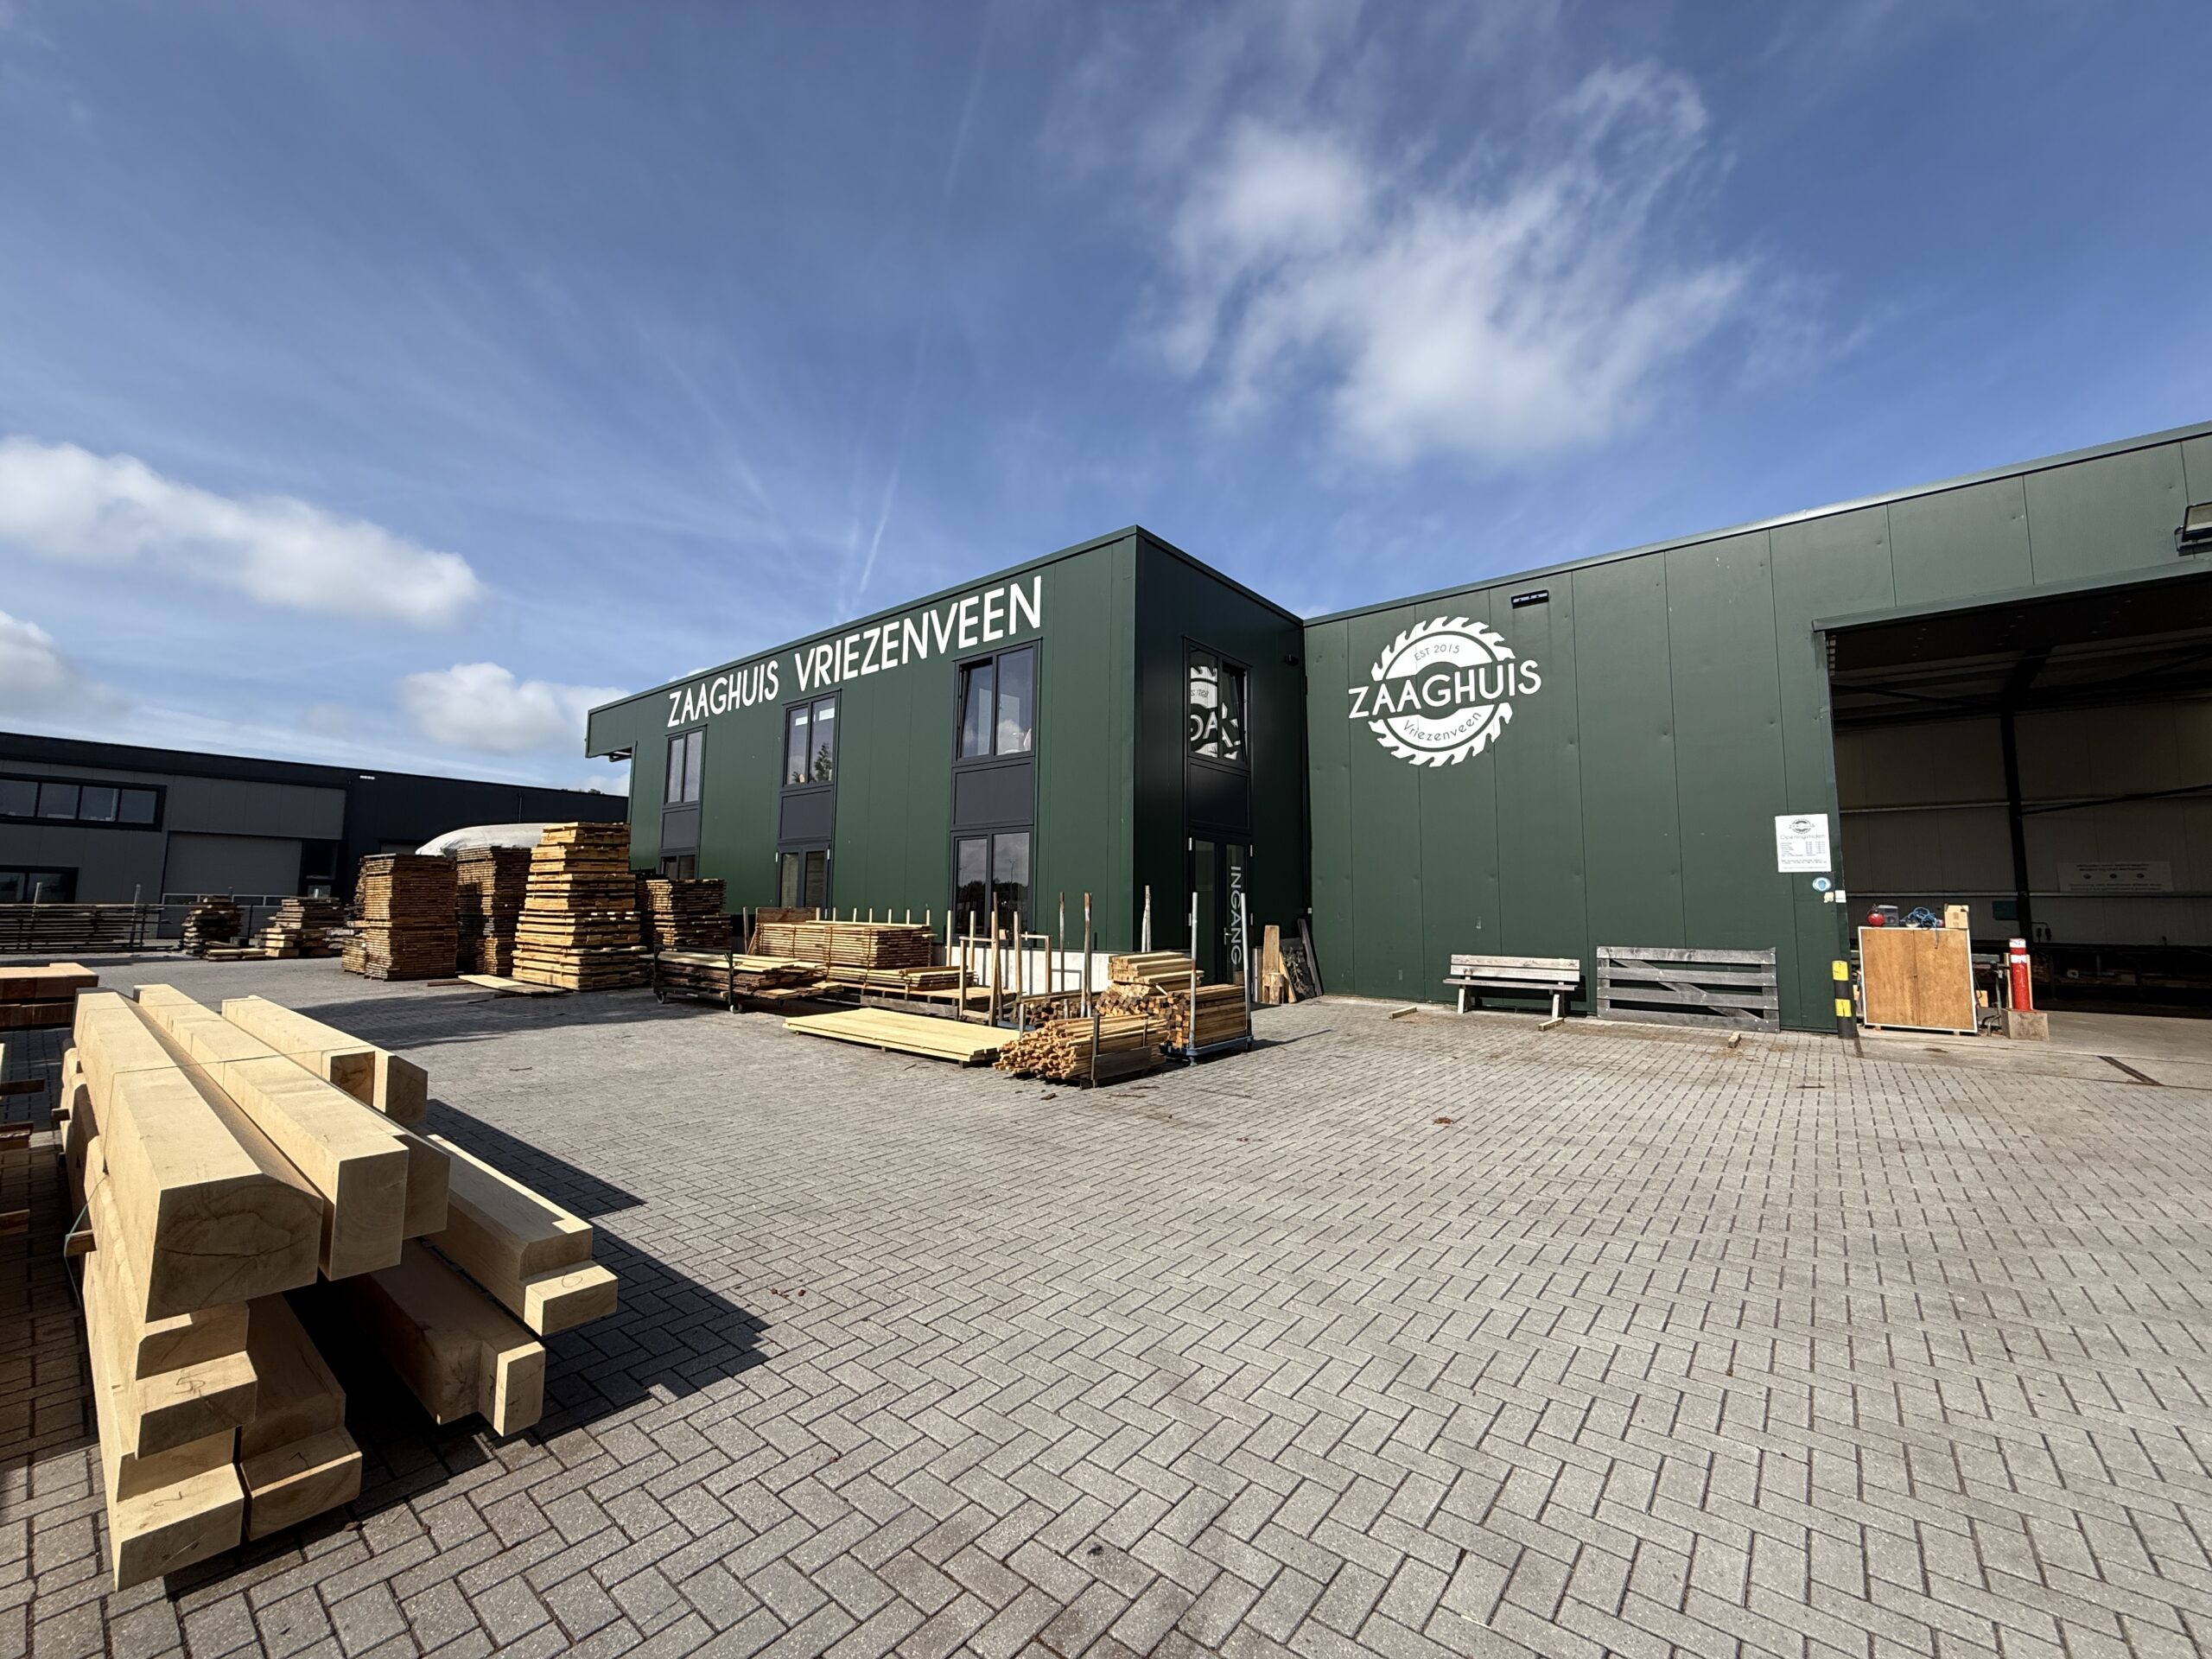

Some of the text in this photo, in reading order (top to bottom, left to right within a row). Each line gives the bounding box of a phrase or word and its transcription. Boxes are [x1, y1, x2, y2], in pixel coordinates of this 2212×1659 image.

[668, 575, 1042, 728] ZAAGHUIS VRIEZENVEEN
[1414, 644, 1460, 661] EST 2015
[1348, 659, 1541, 719] ZAAGHUIS
[1403, 712, 1482, 741] Vriezenveen
[1230, 866, 1243, 965] INGANG
